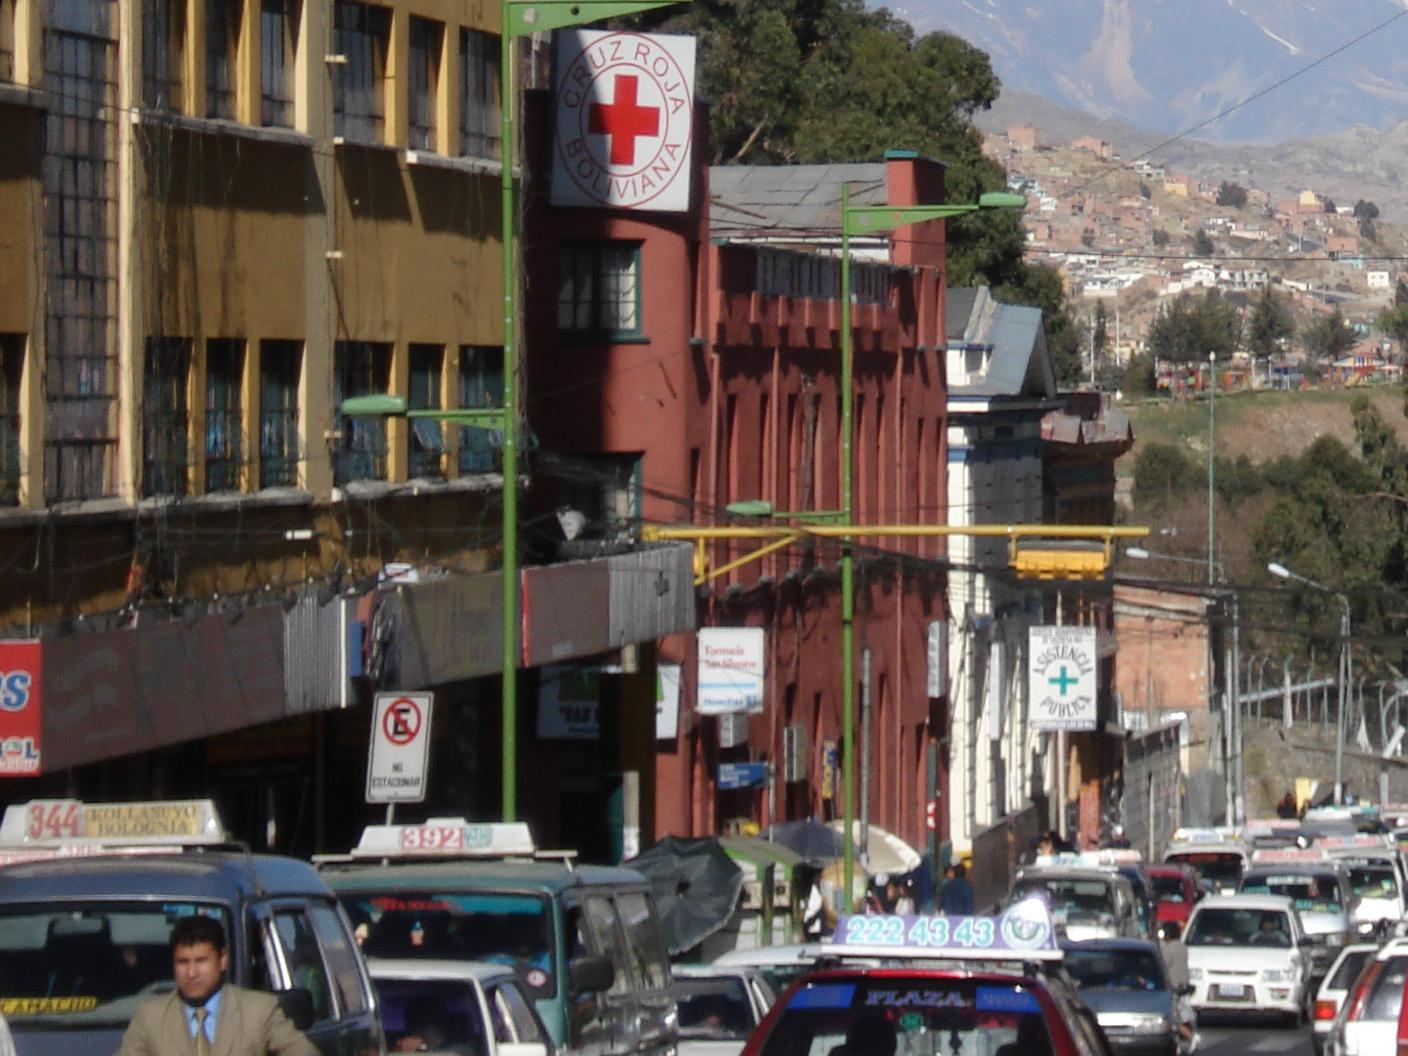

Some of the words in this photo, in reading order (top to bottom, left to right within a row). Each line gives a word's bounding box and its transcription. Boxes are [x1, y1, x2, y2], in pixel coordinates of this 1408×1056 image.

[564, 41, 624, 109] CRUZ
[634, 43, 685, 115] ROJA
[566, 138, 681, 199] BOLIVIANA
[1033, 645, 1093, 676] ASISTENCIA
[29, 804, 80, 839] 344
[402, 826, 462, 849] 392
[845, 915, 905, 944] 222
[908, 916, 950, 946] 43
[953, 916, 995, 947] 43
